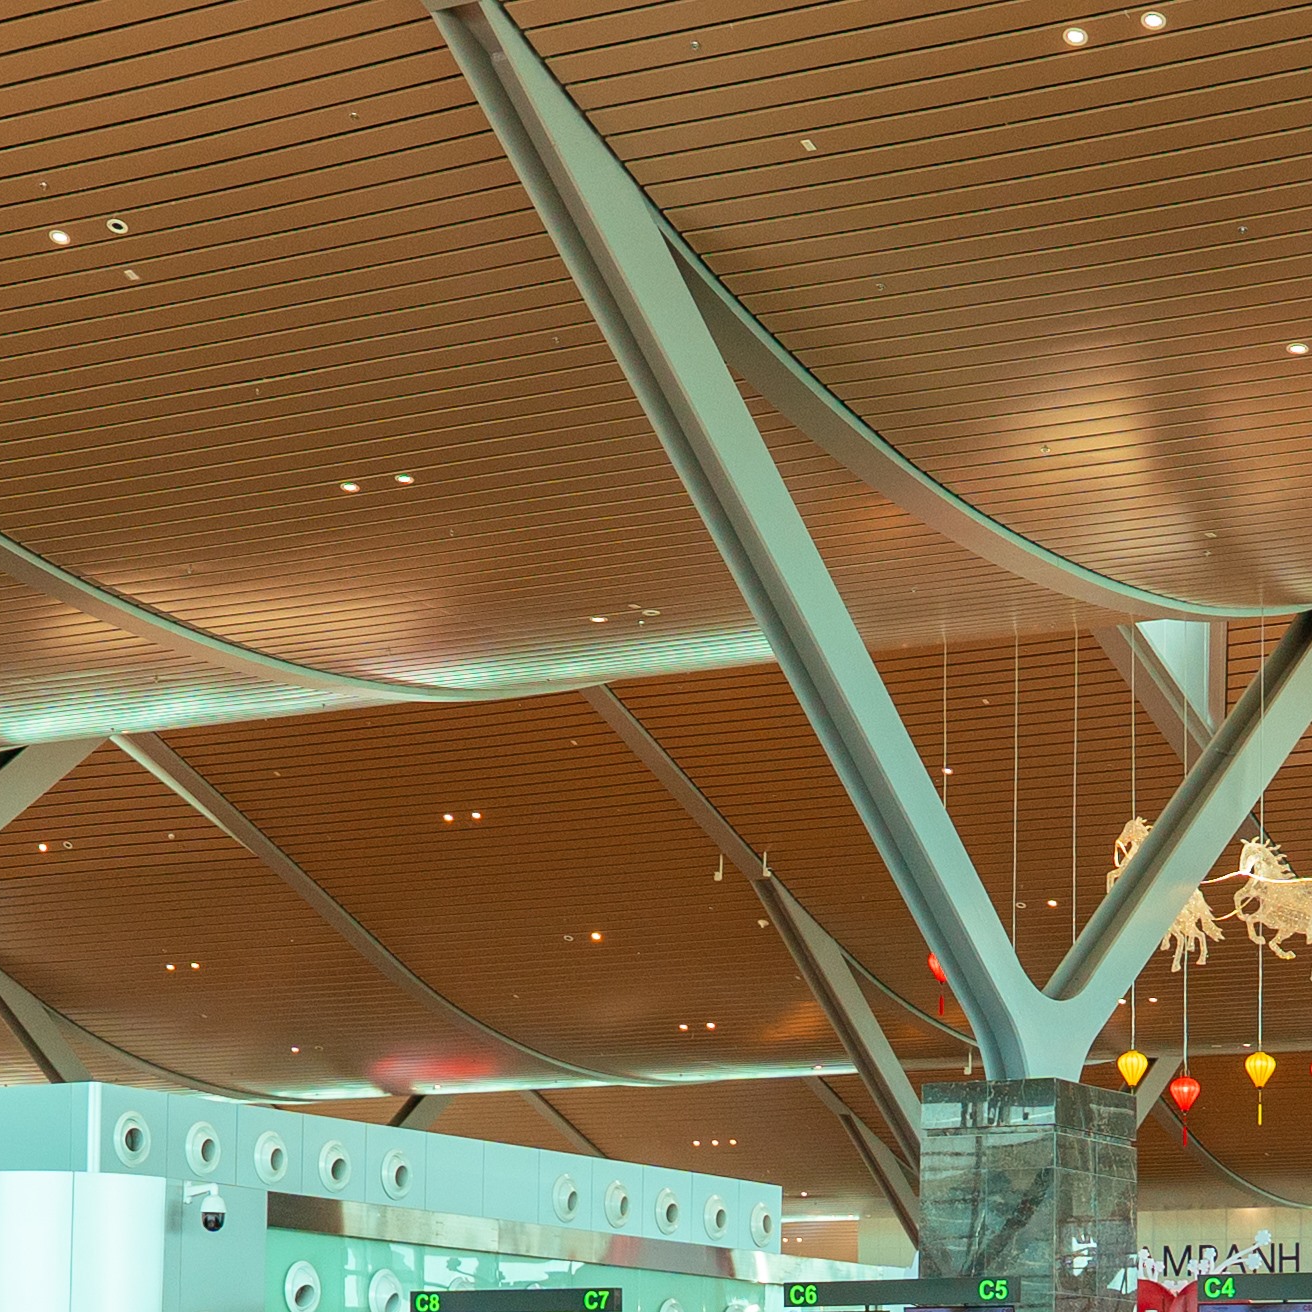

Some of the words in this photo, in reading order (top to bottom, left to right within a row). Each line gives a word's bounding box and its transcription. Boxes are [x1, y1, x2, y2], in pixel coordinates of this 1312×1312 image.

[789, 1284, 817, 1304] C6
[979, 1279, 1008, 1300] C5
[1204, 1277, 1235, 1298] C4
[415, 1294, 440, 1312] C8
[583, 1290, 610, 1310] C7
